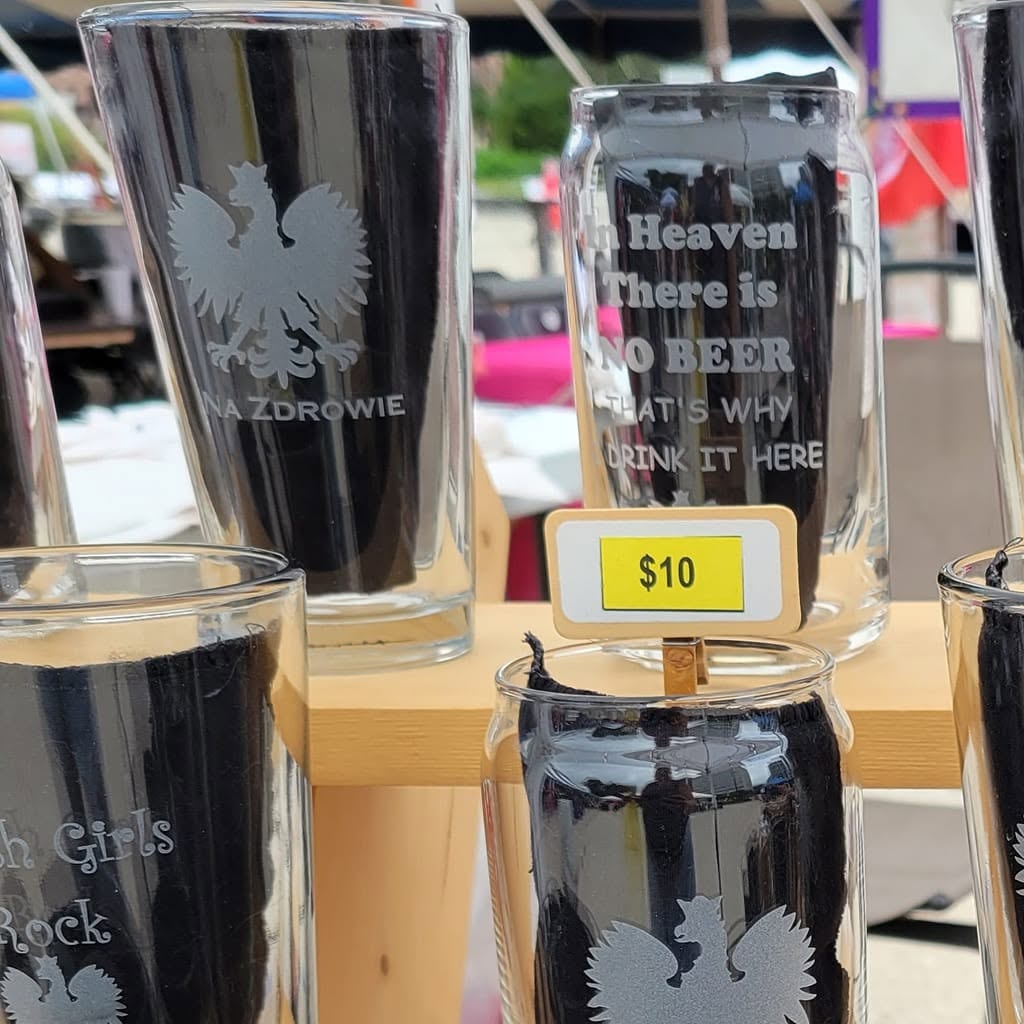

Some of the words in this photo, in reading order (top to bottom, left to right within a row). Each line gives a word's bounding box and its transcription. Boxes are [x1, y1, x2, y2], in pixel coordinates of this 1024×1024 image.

[626, 213, 798, 250] Heaven
[603, 271, 728, 309] There
[738, 271, 778, 308] is
[600, 336, 654, 373] NO
[664, 337, 795, 374] BEER
[202, 391, 243, 420] NA
[249, 394, 406, 421] ZDROWIE
[721, 396, 793, 424] WHY
[607, 442, 688, 473] DRINK
[700, 446, 738, 473] IT
[752, 440, 824, 473] HERE
[639, 554, 695, 592] $10
[54, 808, 175, 874] Girls
